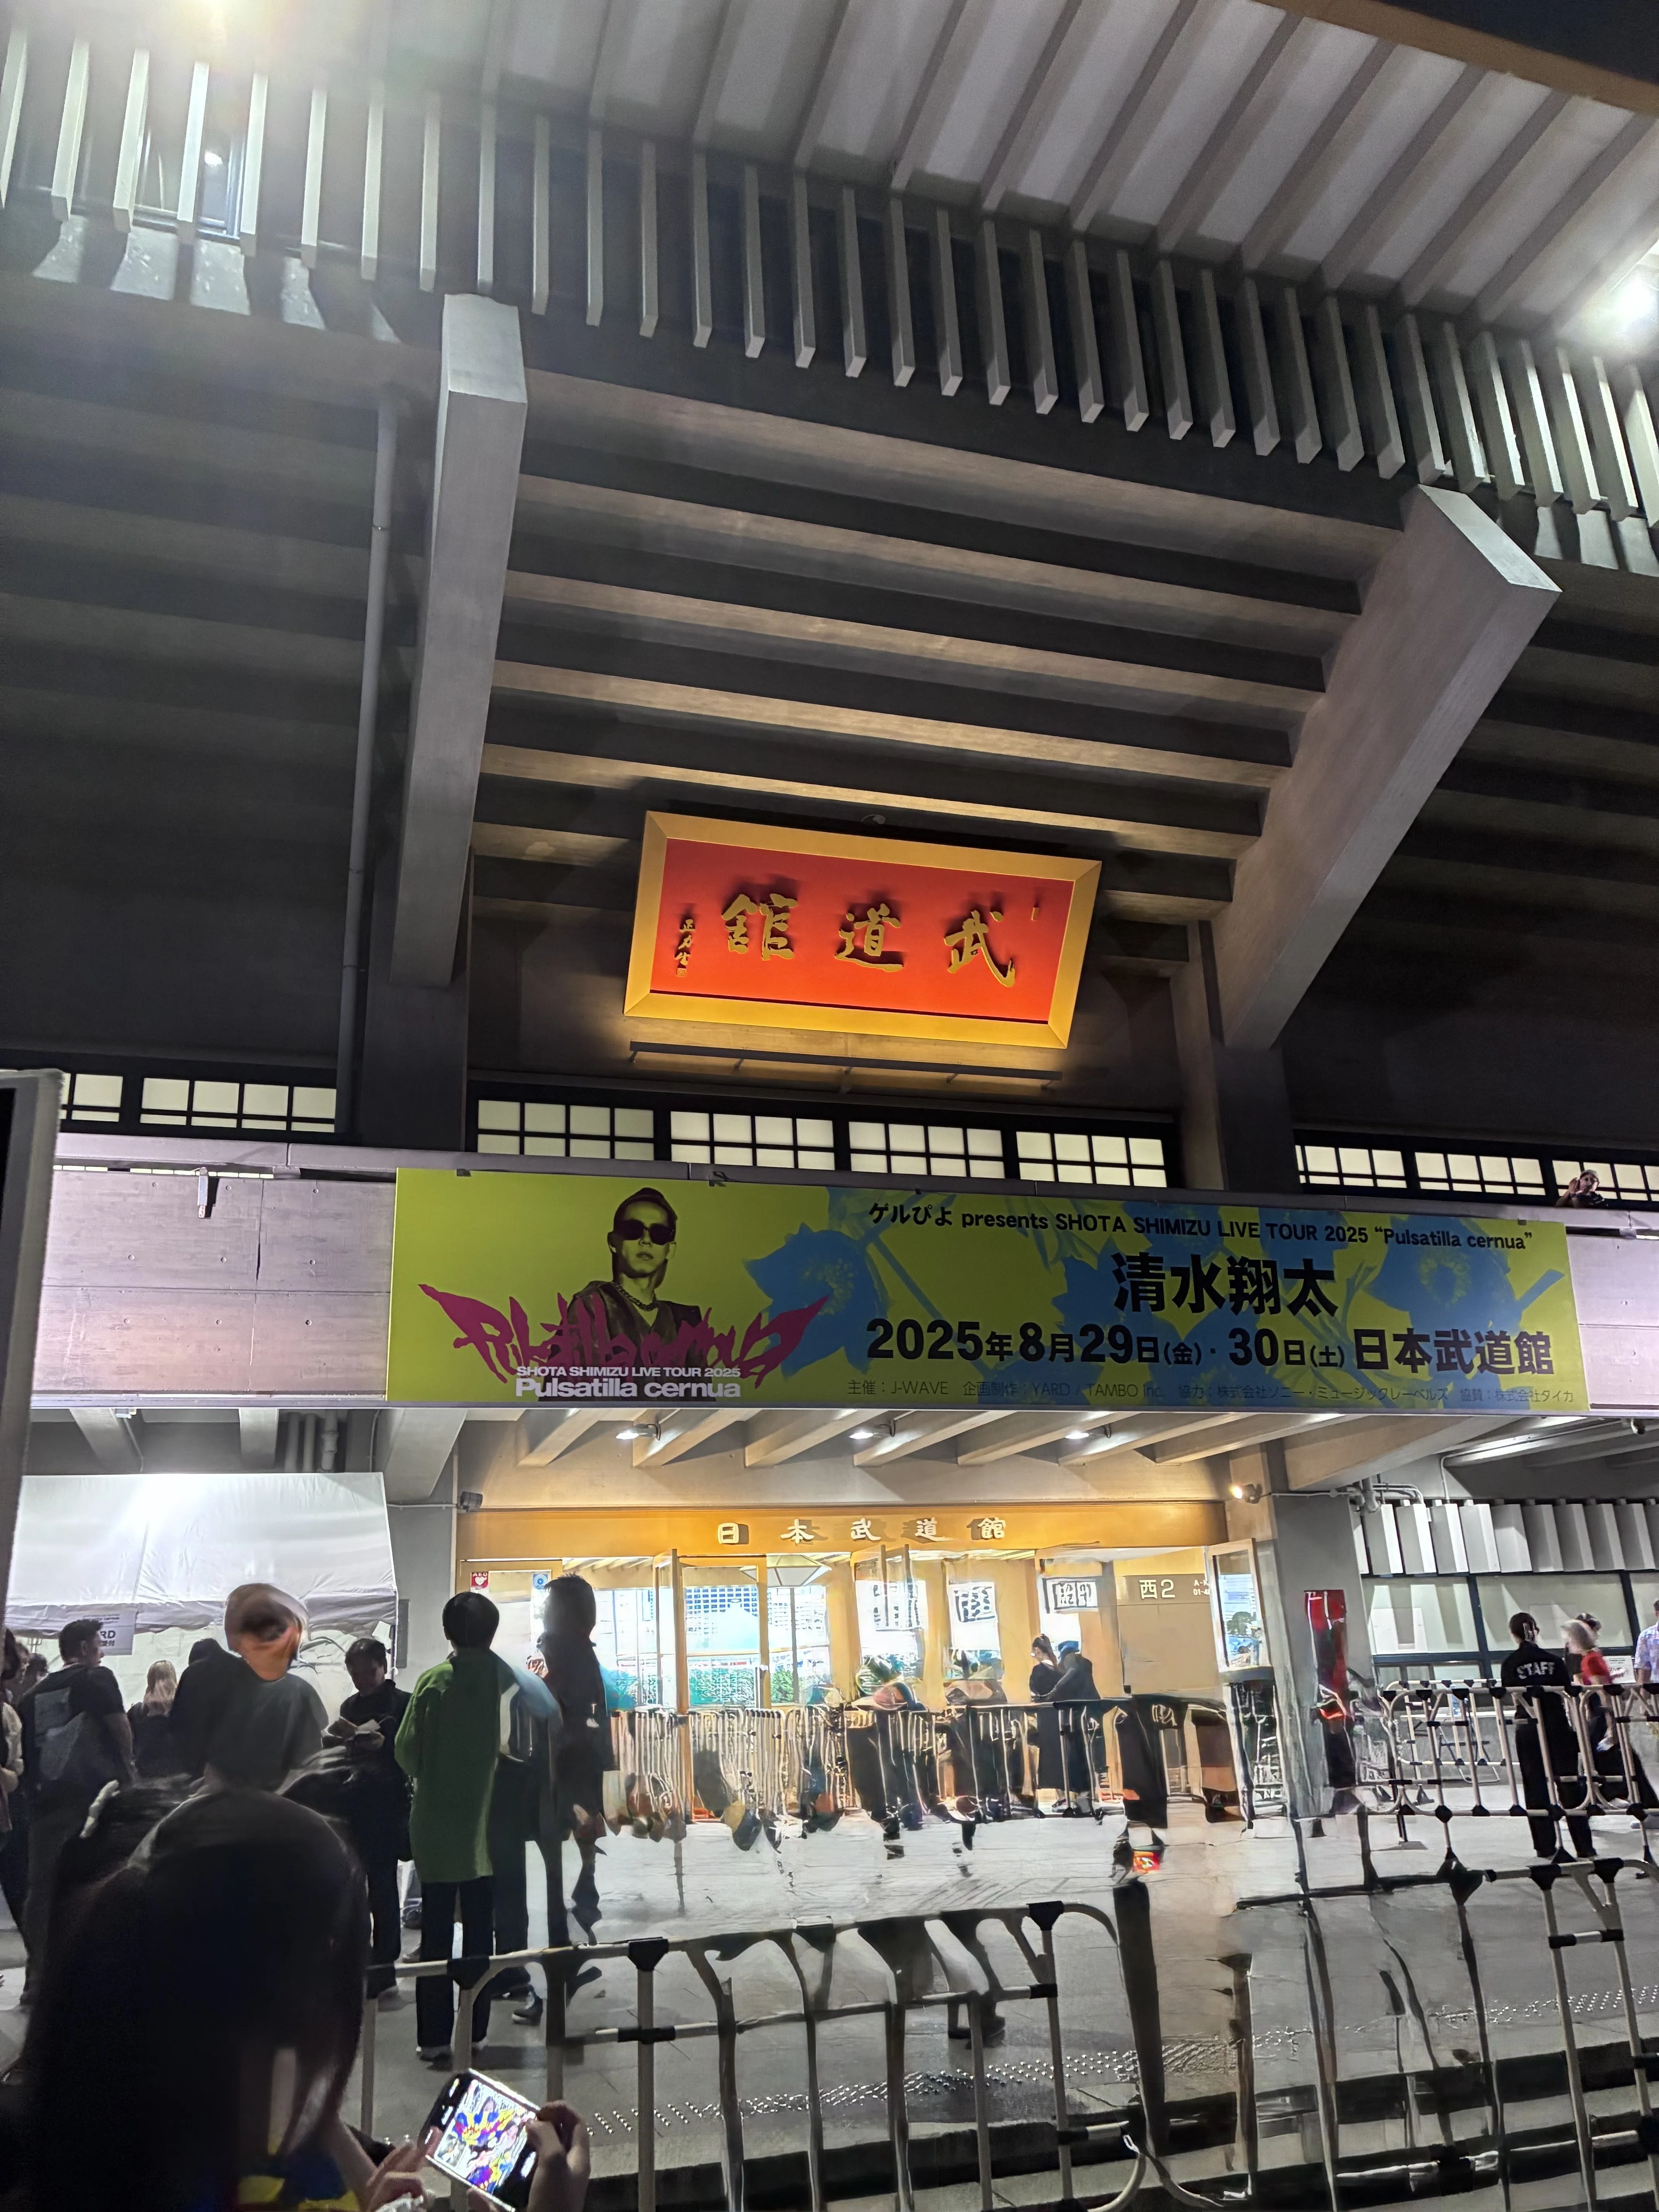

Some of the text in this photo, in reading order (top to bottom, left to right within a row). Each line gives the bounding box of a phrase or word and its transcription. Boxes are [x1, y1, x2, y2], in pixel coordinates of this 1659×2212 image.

[869, 1202, 953, 1226] ゲルぴよ
[962, 1213, 1048, 1229] presents
[1056, 1213, 1127, 1233] SHOTA
[1133, 1217, 1211, 1237] SHIMIZU
[1218, 1221, 1261, 1238] LIVE
[1265, 1223, 1318, 1240] TOUR
[1324, 1224, 1369, 1243] 2025
[1111, 1252, 1338, 1317] 清水翔太
[1353, 1328, 1554, 1374] 日本武道館
[516, 1366, 741, 1378] SHOTA SHIMIZU LIVE TOUR 2025
[516, 1377, 741, 1398] Pulsatilla cernua
[1087, 1383, 1139, 1396] TAMBO
[717, 1517, 1006, 1544] 日本武道館
[1139, 1579, 1176, 1599] 西2
[1517, 1661, 1556, 1680] STAFF
